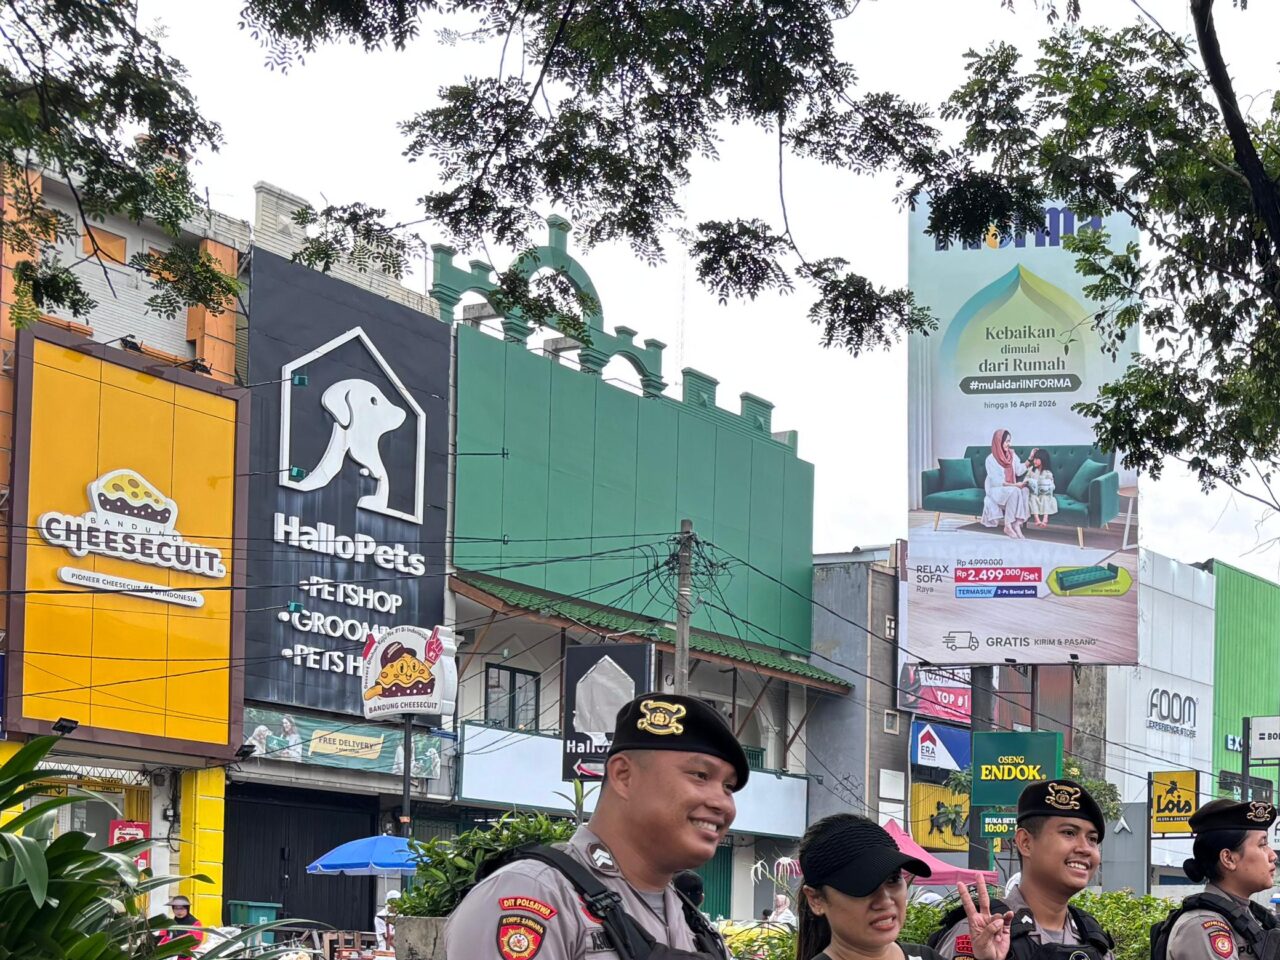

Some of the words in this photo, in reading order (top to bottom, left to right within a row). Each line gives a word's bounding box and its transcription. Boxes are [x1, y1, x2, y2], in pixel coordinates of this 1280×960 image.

[985, 325, 1056, 341] Kebaikan
[1000, 343, 1040, 355] dimulai
[978, 358, 1009, 373] dari
[1013, 357, 1066, 372] Rumah
[969, 377, 1072, 391] #mulaidariINFORMA
[983, 401, 1009, 410] hingga
[1019, 400, 1037, 409] April
[90, 517, 179, 542] BANDUNG
[45, 517, 218, 572] CHEESECUIT
[274, 512, 426, 576] HalloPets
[916, 565, 949, 574] RELAX
[71, 572, 101, 584] PIONEER
[916, 574, 943, 584] SOFA
[309, 575, 403, 614] PETSHOP
[916, 585, 934, 594] Raya
[291, 609, 389, 643] GROOM
[985, 637, 1030, 647] GRATIS
[1034, 638, 1056, 646] KIRIM
[937, 690, 955, 704] TOP
[369, 702, 399, 714] BANDUNG
[400, 701, 438, 710] CHEESECUIT
[318, 736, 337, 745] FREE
[921, 745, 936, 756] ERA
[998, 755, 1025, 764] OSENG
[980, 764, 1042, 780] ENDOK
[1156, 794, 1192, 814] Lois
[984, 824, 1008, 833] 10:00
[503, 899, 515, 907] DIT
